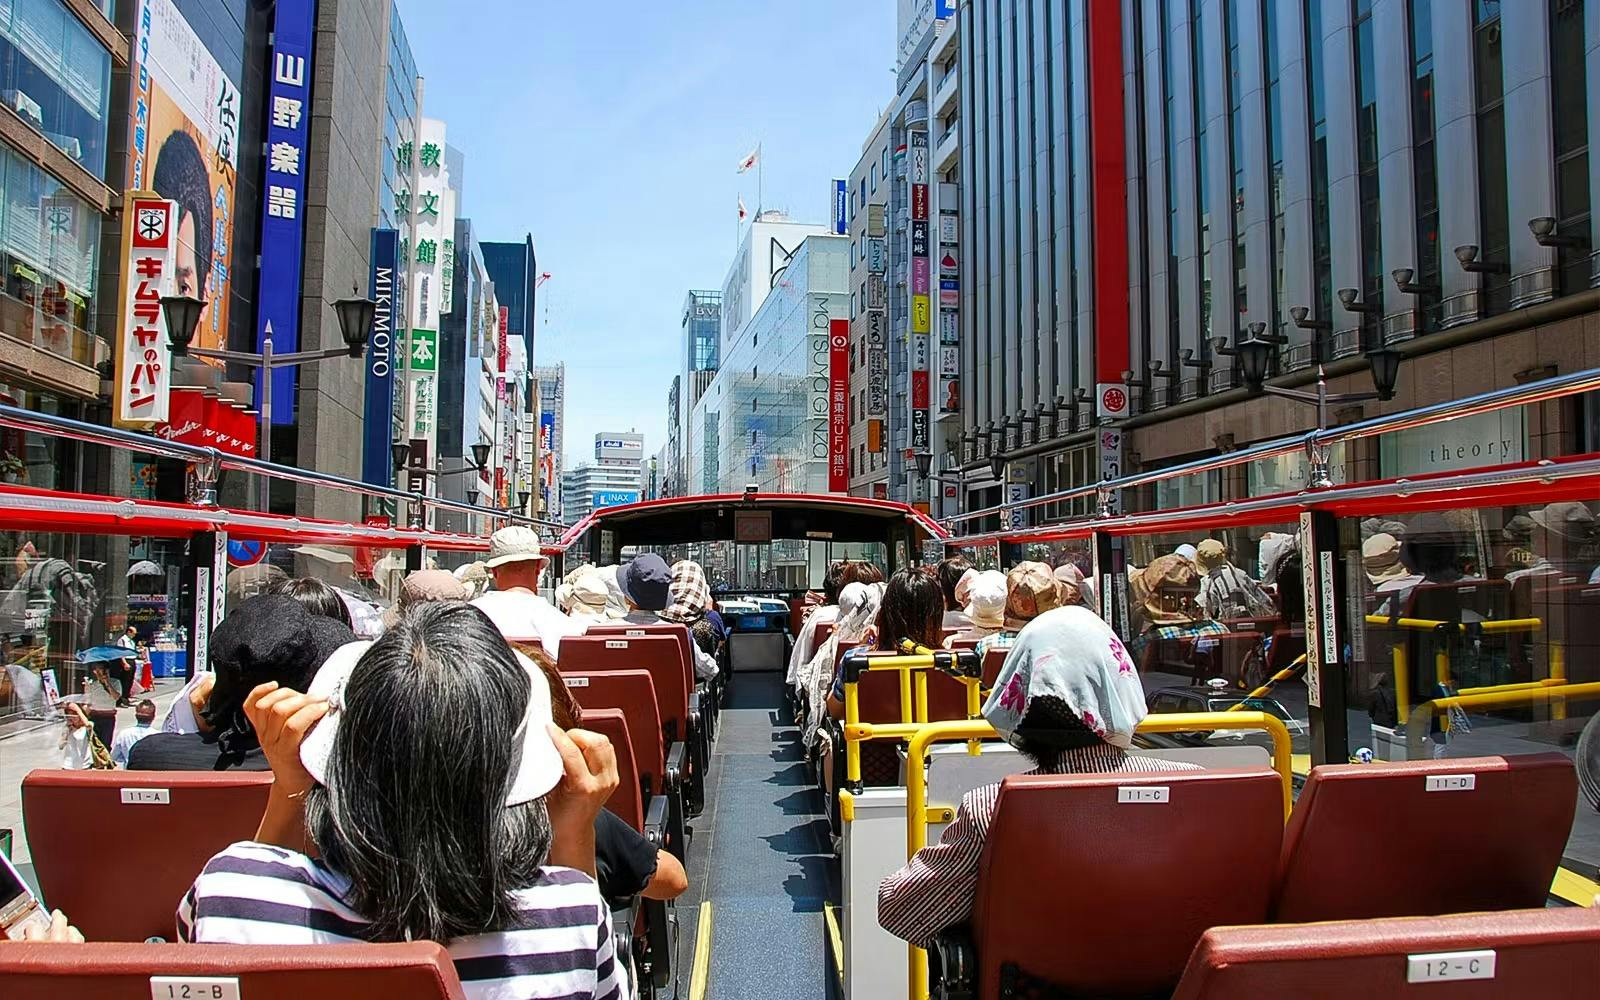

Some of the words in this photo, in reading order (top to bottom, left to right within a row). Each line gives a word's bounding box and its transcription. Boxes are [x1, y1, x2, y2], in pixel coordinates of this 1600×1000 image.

[269, 53, 304, 219] 山野楽器
[416, 141, 441, 265] 教文館
[373, 267, 392, 377] MIKIMOTO
[696, 307, 721, 315] BV
[130, 257, 162, 409] キムラヤのパン
[871, 312, 881, 342] ざくろ
[412, 336, 434, 364] 本
[415, 378, 427, 432] ナルニア国
[159, 421, 200, 440] Fender
[834, 380, 845, 476] 三菱東京UFJ銀行
[1430, 438, 1512, 464] theory
[1289, 463, 1346, 482] thry
[608, 493, 629, 502] INAX
[196, 569, 207, 671] シートベルトをおしめ下
[1301, 516, 1319, 700] シートベルトをおしめ下さい
[1128, 789, 1161, 801] 11-C
[1435, 777, 1467, 788] 11-D
[130, 792, 160, 801] 11-A
[1425, 958, 1481, 977] 12-C
[168, 984, 223, 999] 12-B
